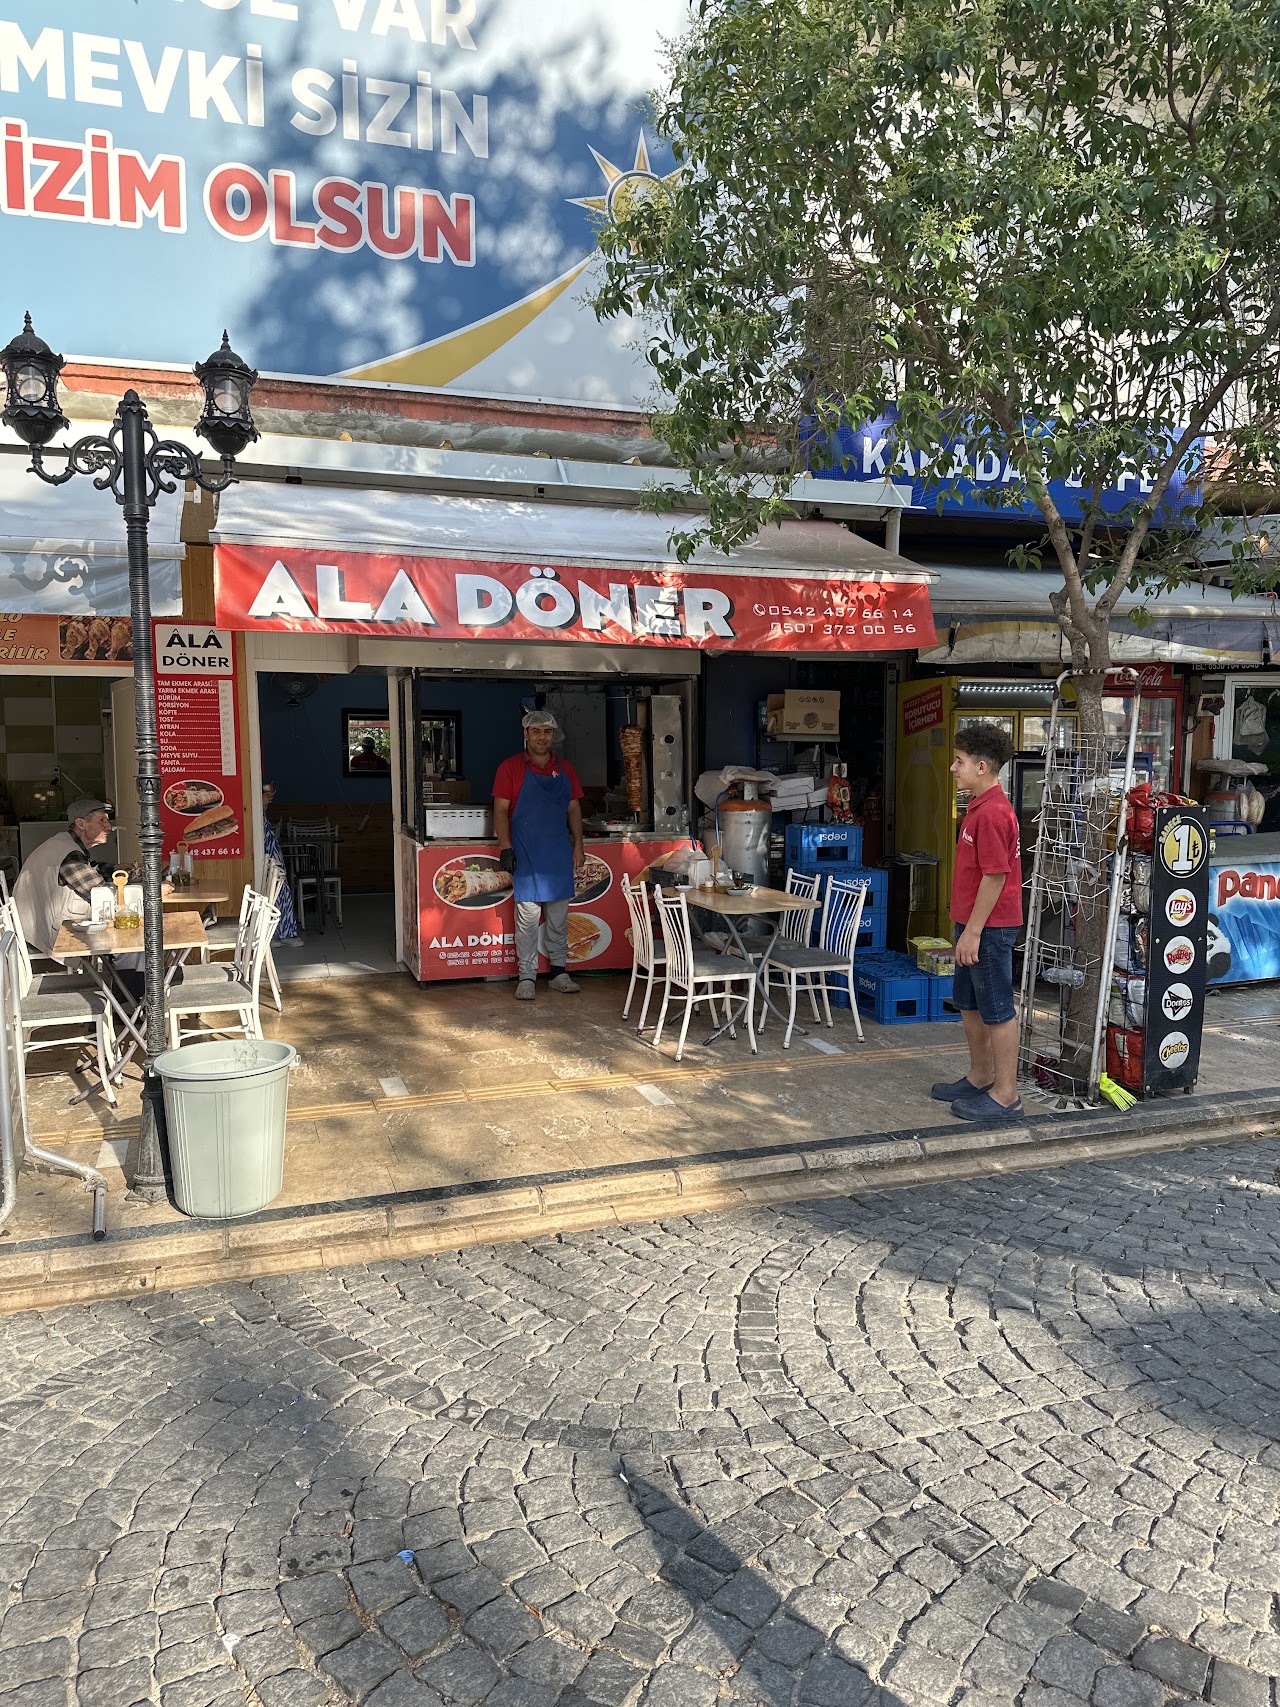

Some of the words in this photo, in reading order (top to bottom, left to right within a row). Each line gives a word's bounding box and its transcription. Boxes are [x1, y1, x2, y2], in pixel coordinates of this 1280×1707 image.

[0, 19, 265, 127] MEVKİ
[290, 58, 489, 159] SİZİN
[203, 161, 476, 268] OLSUN
[247, 559, 440, 627] ALA
[455, 566, 738, 640] DÖNER
[768, 605, 816, 617] 0542
[823, 606, 857, 619] 437
[862, 608, 883, 620] 66
[892, 608, 914, 620] 14
[165, 628, 223, 649] ÂLÂ
[770, 622, 815, 634] 0501
[822, 622, 856, 635] 373
[862, 624, 886, 636] 00
[893, 623, 917, 635] 56
[162, 653, 230, 668] DÖNER
[1114, 665, 1166, 687] CocCola
[158, 708, 178, 716] KÖFTE
[904, 698, 941, 720] KORUYUCU
[1158, 814, 1182, 844] SADECE
[201, 848, 216, 856] 437
[1169, 899, 1194, 918] Lay's
[429, 936, 464, 949] ALA
[467, 932, 515, 947] DÖNE
[1165, 999, 1192, 1008] Doritos
[1160, 1040, 1189, 1062] Cheetos
